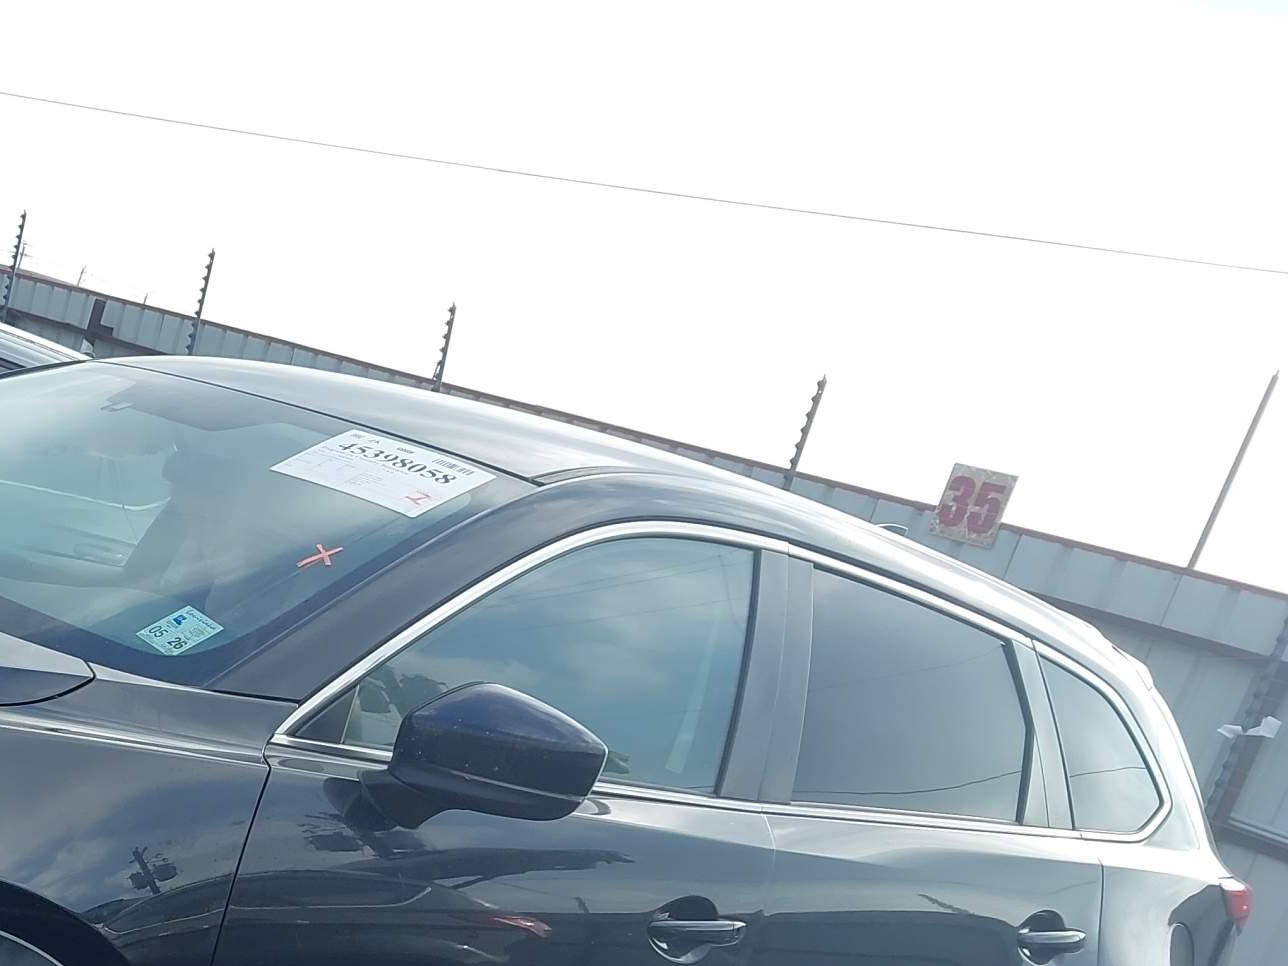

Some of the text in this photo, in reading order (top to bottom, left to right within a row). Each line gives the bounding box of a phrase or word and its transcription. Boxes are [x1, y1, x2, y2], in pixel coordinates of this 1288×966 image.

[338, 443, 457, 484] 45398058
[937, 475, 1006, 533] 35
[148, 625, 188, 650] 05 26
